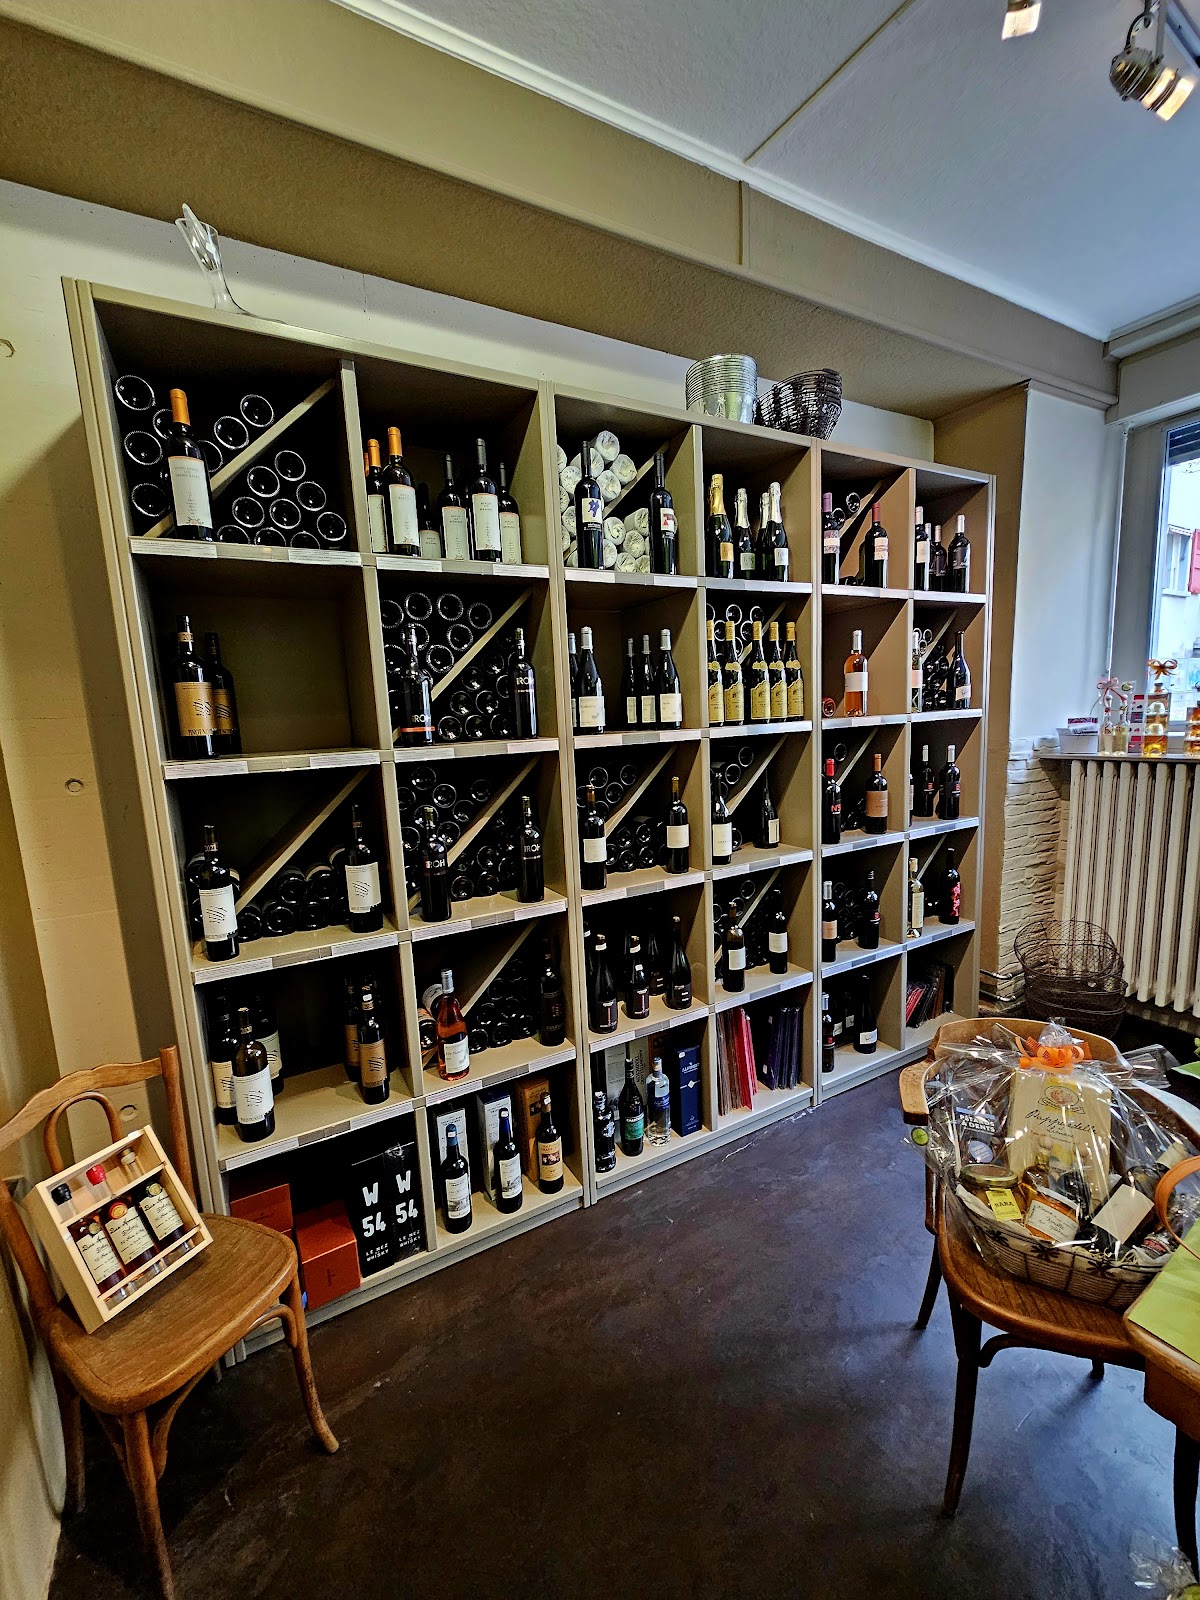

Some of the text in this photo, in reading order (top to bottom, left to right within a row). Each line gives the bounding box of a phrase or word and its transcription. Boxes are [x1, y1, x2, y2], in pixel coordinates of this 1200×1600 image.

[396, 1170, 411, 1193] W
[362, 1182, 378, 1206] W
[395, 1198, 418, 1223] 54
[362, 1212, 386, 1237] 54
